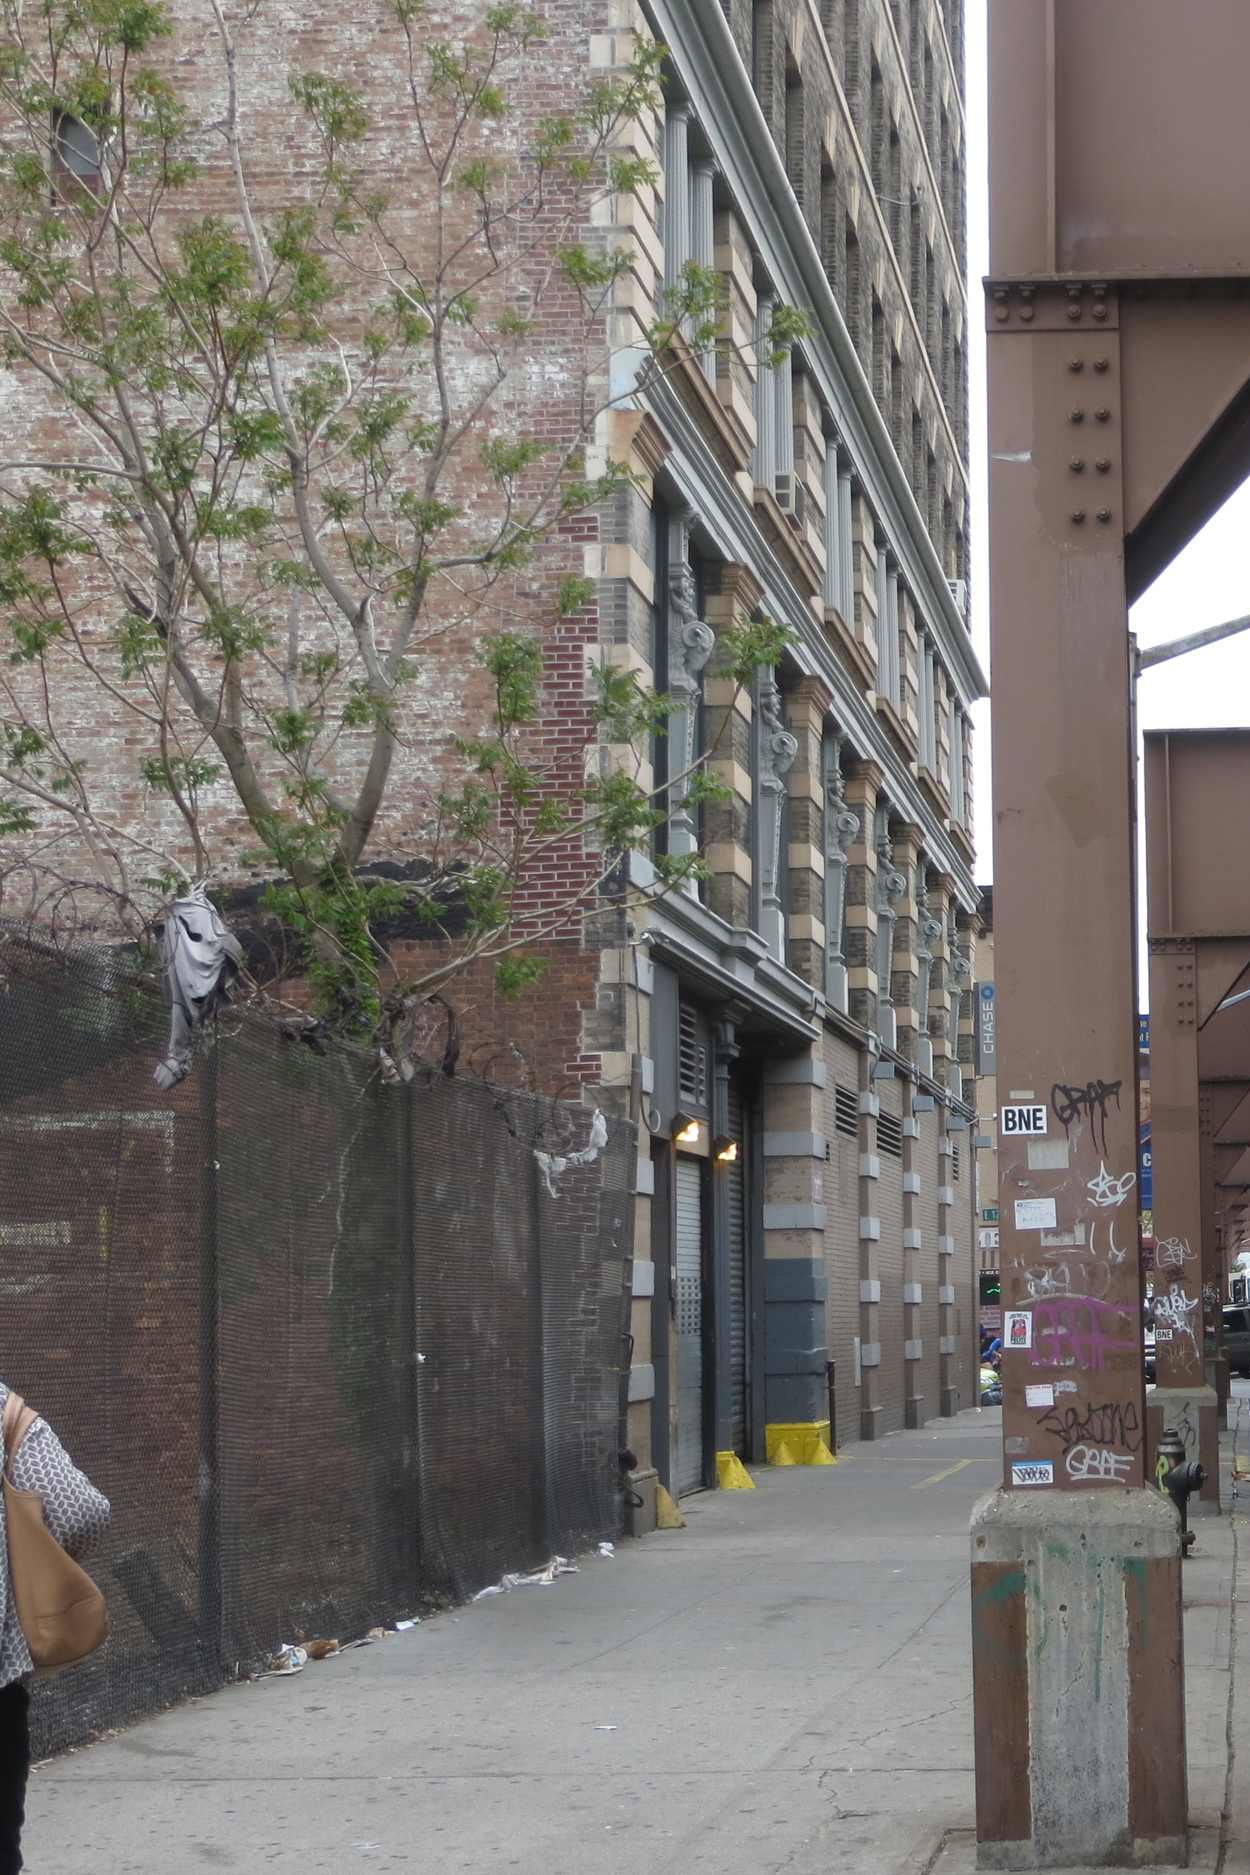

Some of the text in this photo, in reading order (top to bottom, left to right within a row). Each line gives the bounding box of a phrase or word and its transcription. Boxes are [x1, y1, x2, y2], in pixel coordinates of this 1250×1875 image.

[982, 1002, 994, 1054] CHASE
[1004, 1108, 1044, 1132] BNE
[1157, 1330, 1172, 1339] BNE
